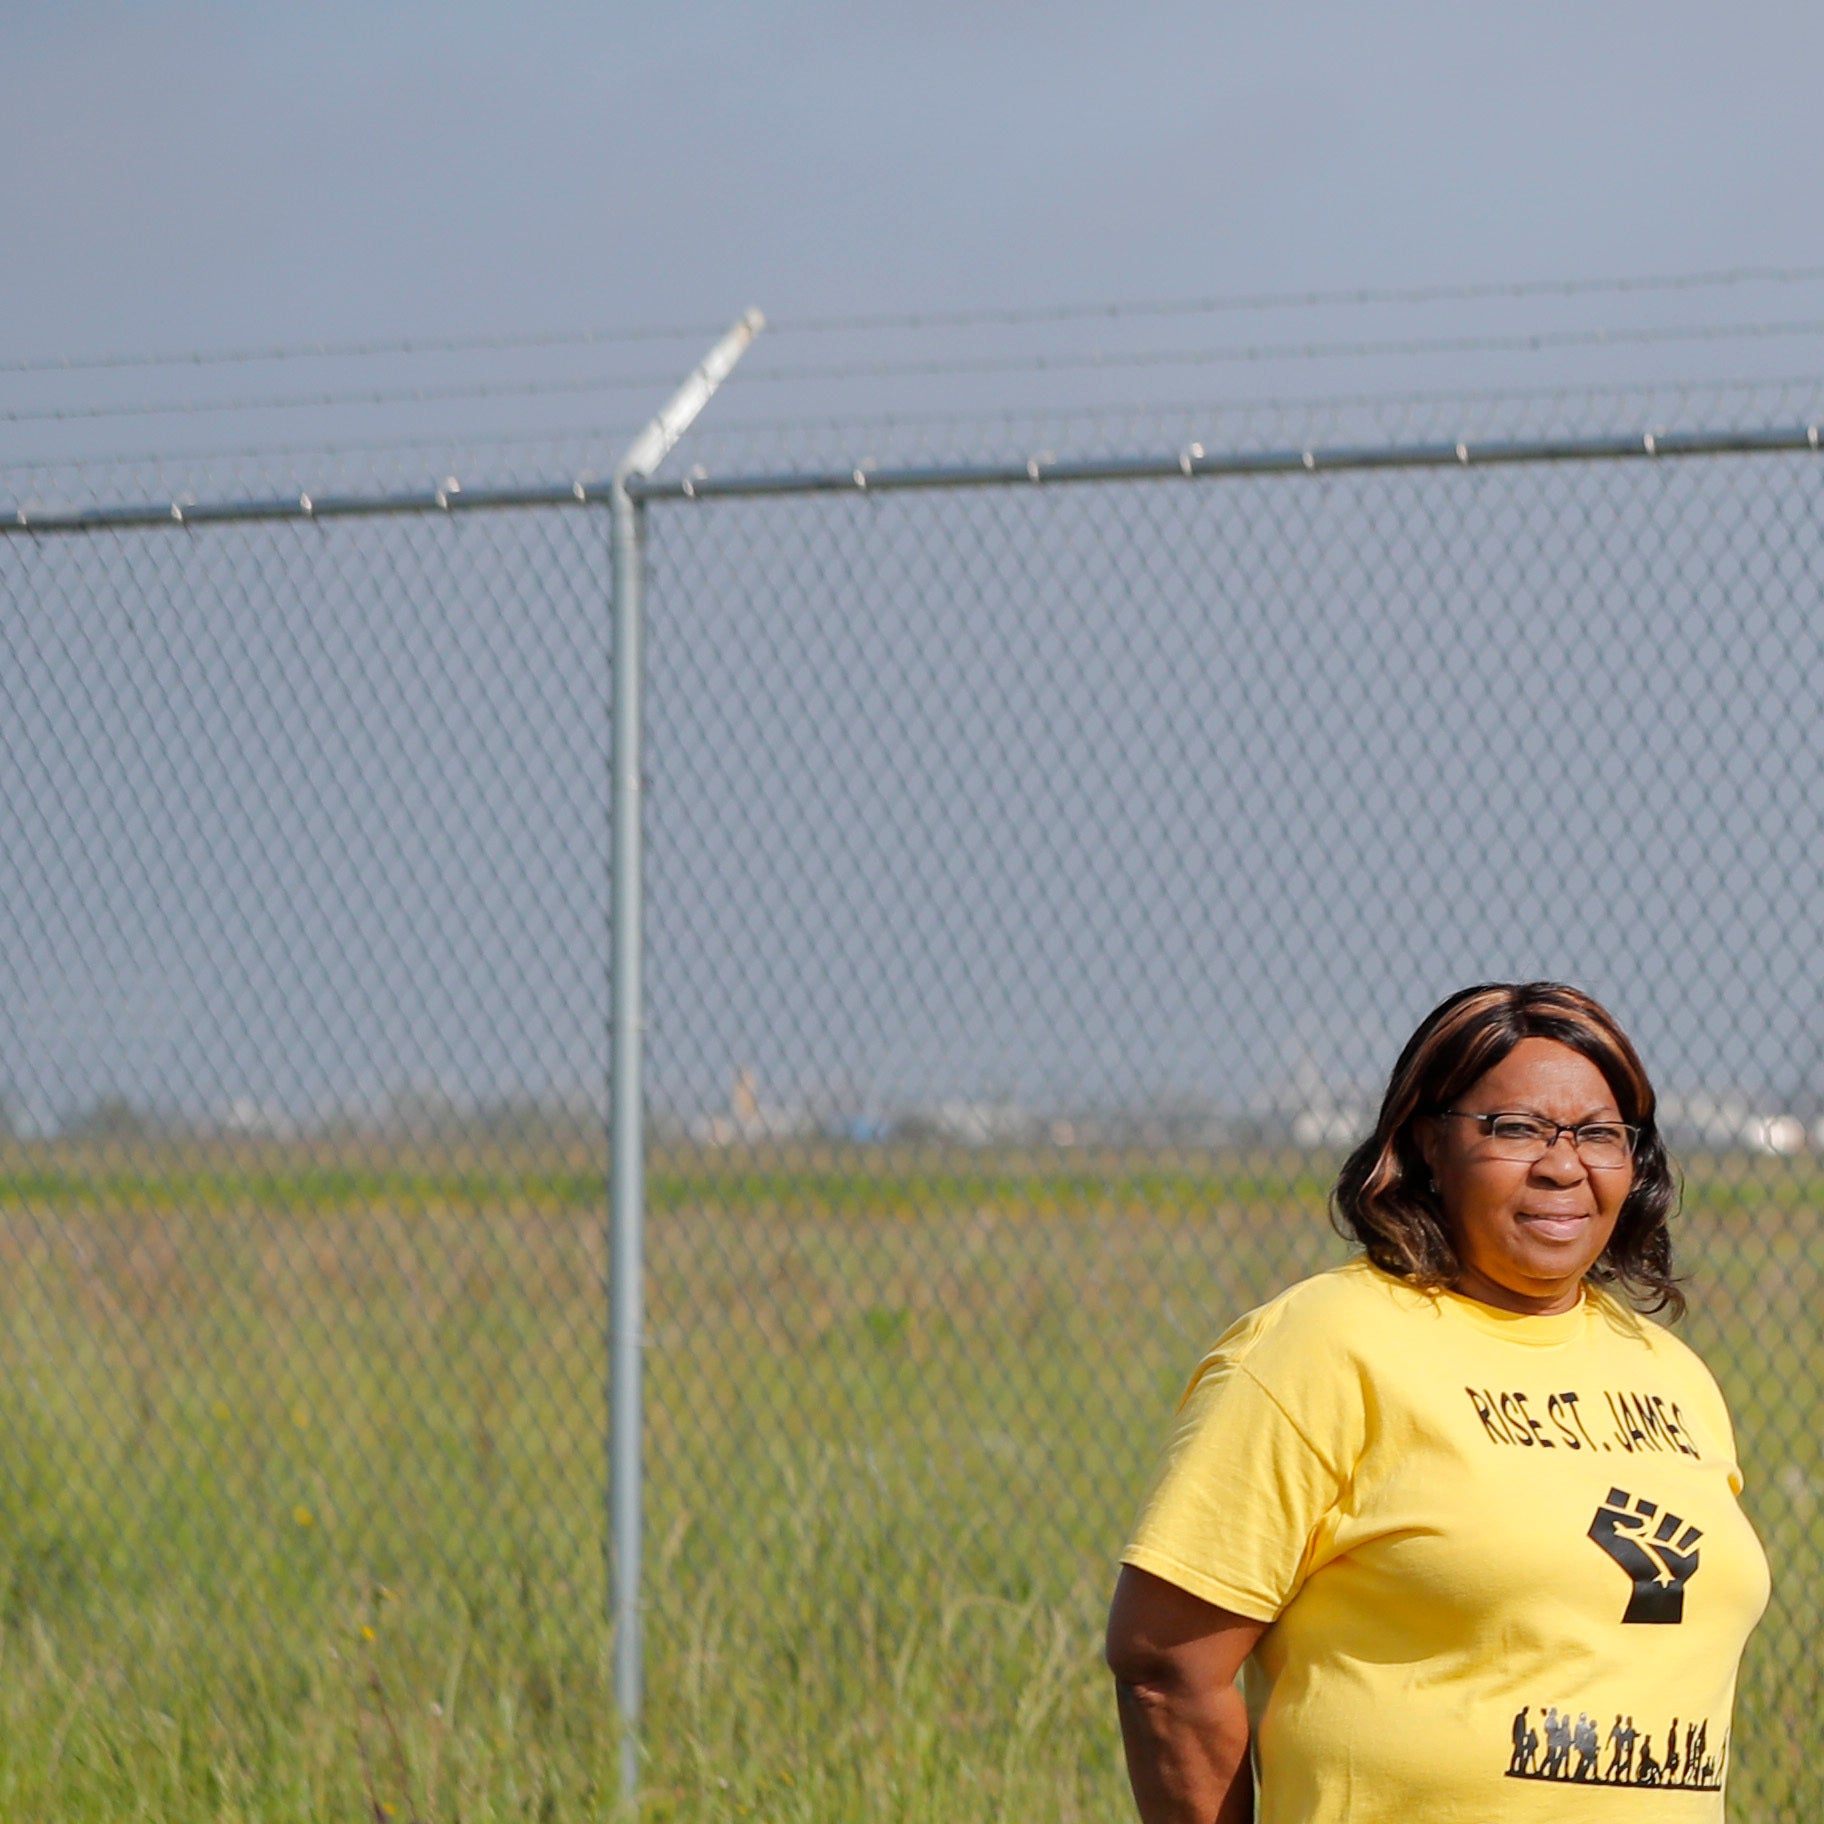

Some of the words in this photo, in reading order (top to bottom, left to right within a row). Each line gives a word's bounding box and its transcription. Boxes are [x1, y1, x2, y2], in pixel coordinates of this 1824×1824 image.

[1464, 1386, 1556, 1448] RISE
[1547, 1391, 1612, 1452] ST.
[1603, 1390, 1702, 1461] JAMES
